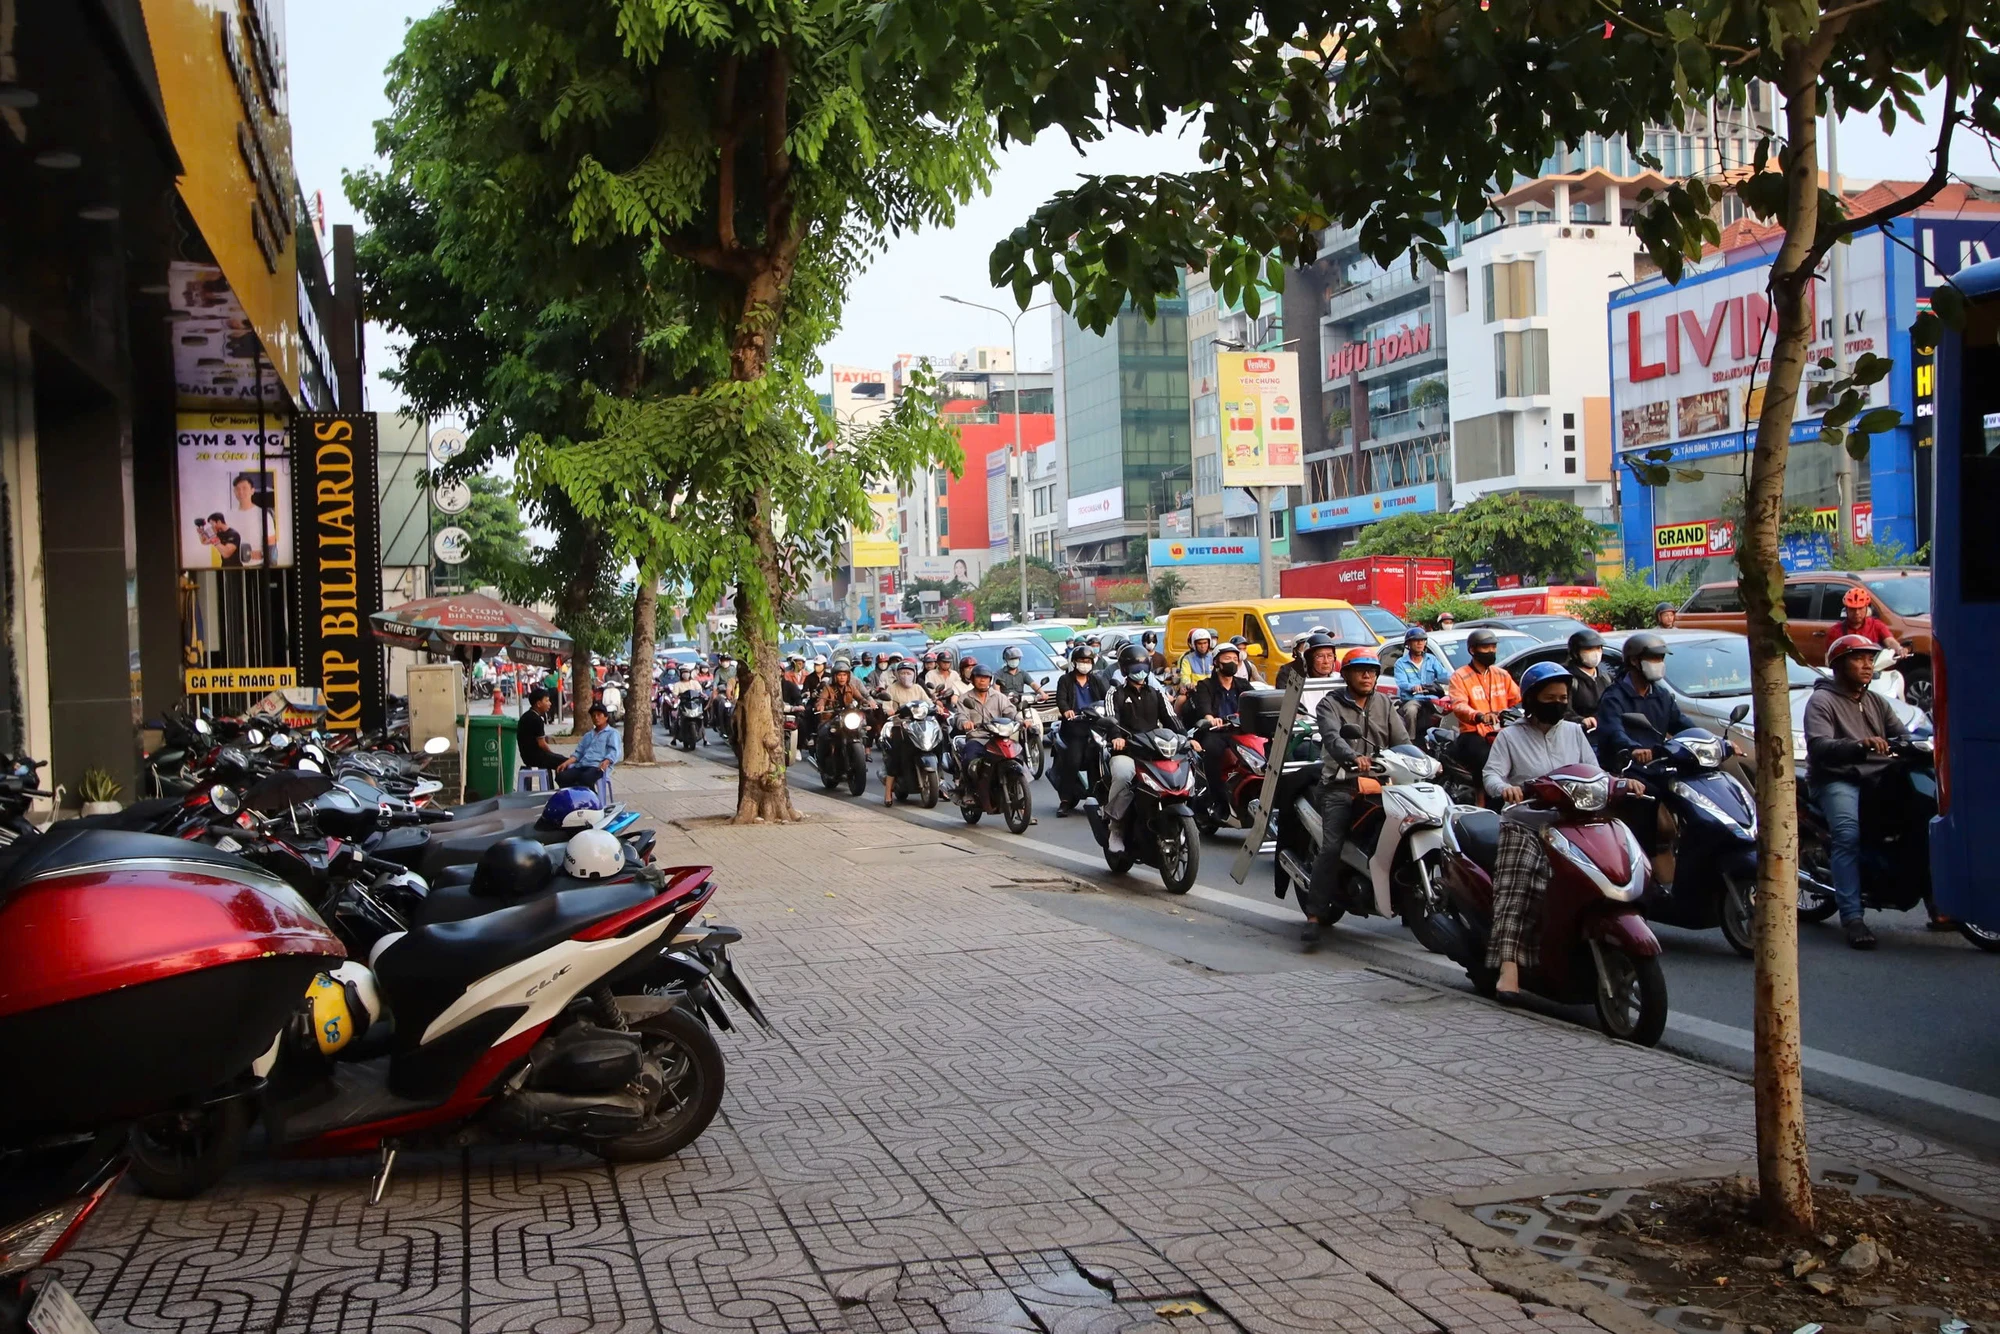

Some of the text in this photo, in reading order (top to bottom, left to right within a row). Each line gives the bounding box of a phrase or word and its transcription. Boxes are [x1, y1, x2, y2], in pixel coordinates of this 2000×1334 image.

[1821, 308, 1866, 341] ITLY
[1373, 323, 1431, 367] TOÀN
[1712, 366, 1742, 383] BRAND
[178, 433, 219, 446] GYM
[224, 433, 237, 446] &
[1721, 438, 1735, 449] HCM
[1382, 495, 1417, 508] VIETBANK
[1320, 506, 1349, 518] VIETBANK
[314, 420, 359, 639] BILLIARDS
[1658, 527, 1704, 546] GRAND
[1187, 545, 1244, 555] VIETBANK
[1339, 568, 1366, 583] viettel
[383, 621, 417, 637] CHIN-SU
[453, 631, 498, 643] CHIN-SU
[531, 636, 560, 649] CHIN-SU
[212, 672, 234, 688] PHÊ
[239, 674, 275, 687] MANG
[322, 650, 361, 730] KTP
